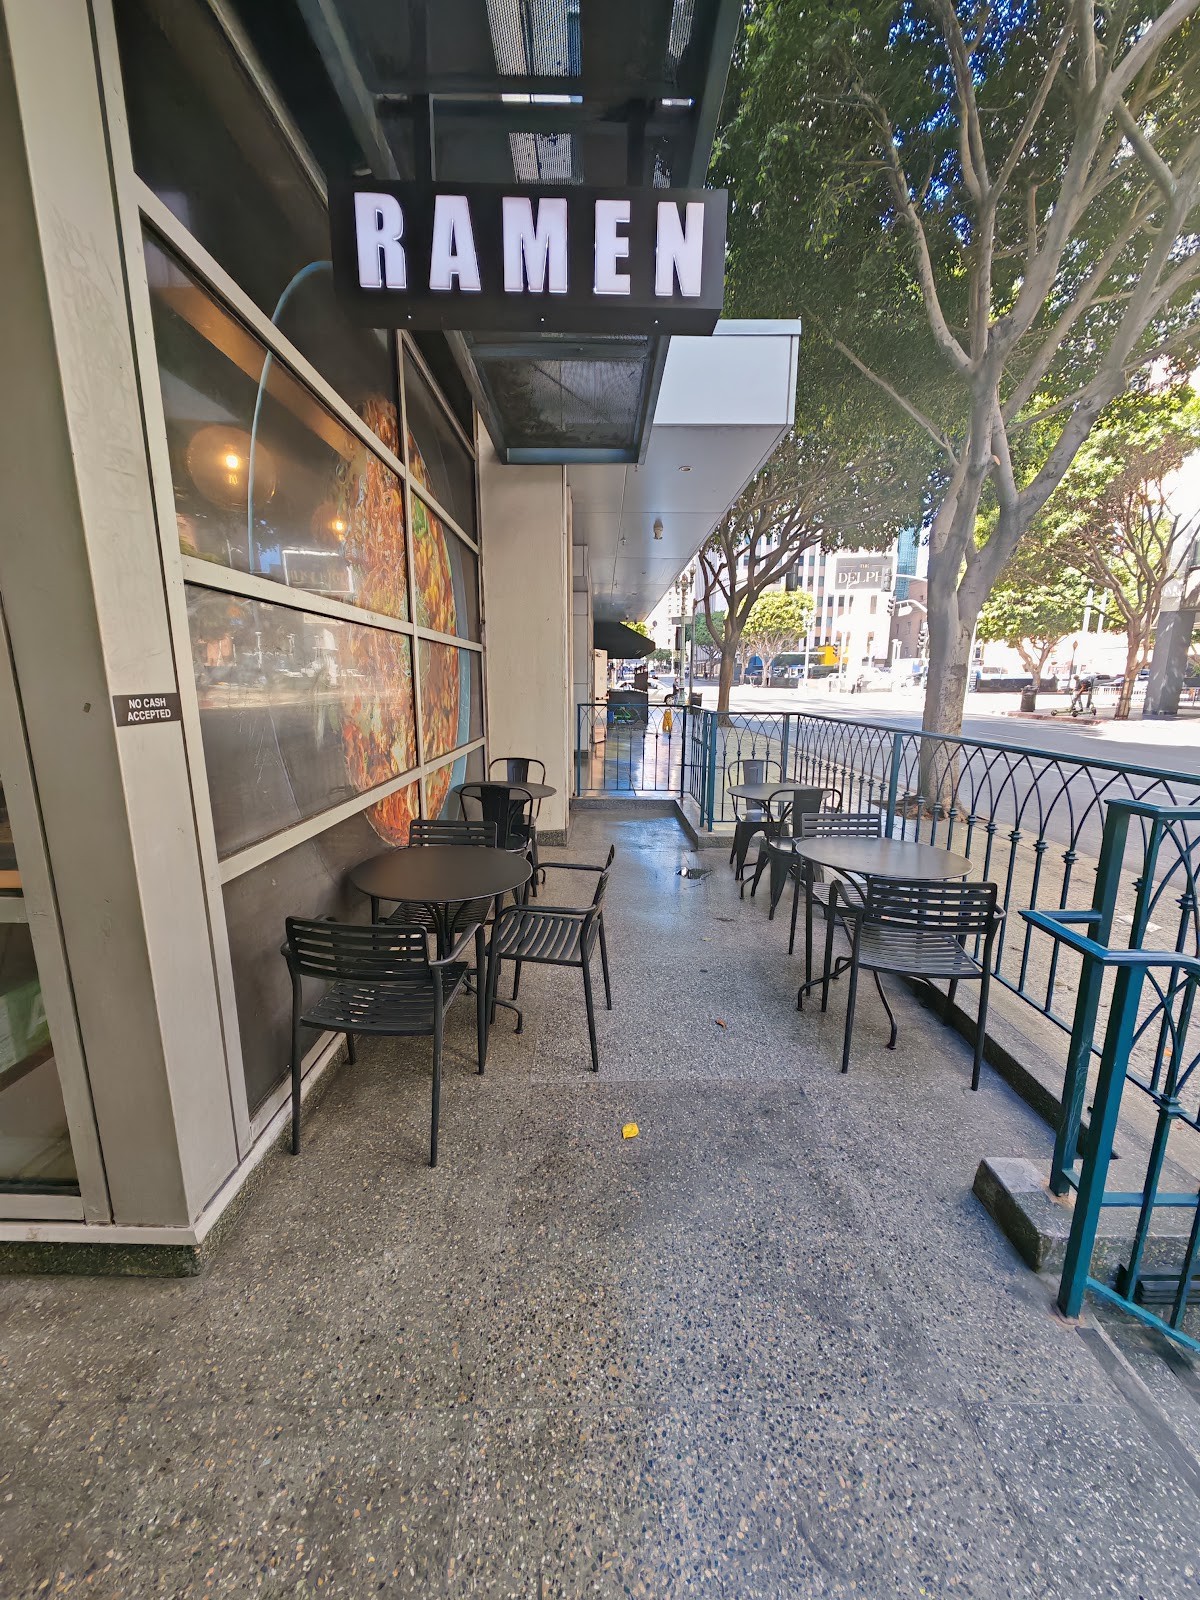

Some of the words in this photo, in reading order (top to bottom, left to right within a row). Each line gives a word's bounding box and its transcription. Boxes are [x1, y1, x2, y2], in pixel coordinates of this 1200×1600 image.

[354, 192, 704, 296] RAMEN
[838, 571, 884, 584] DELPH
[129, 699, 141, 709] NO
[143, 698, 166, 708] CASH
[127, 709, 171, 721] ACCEPTED
